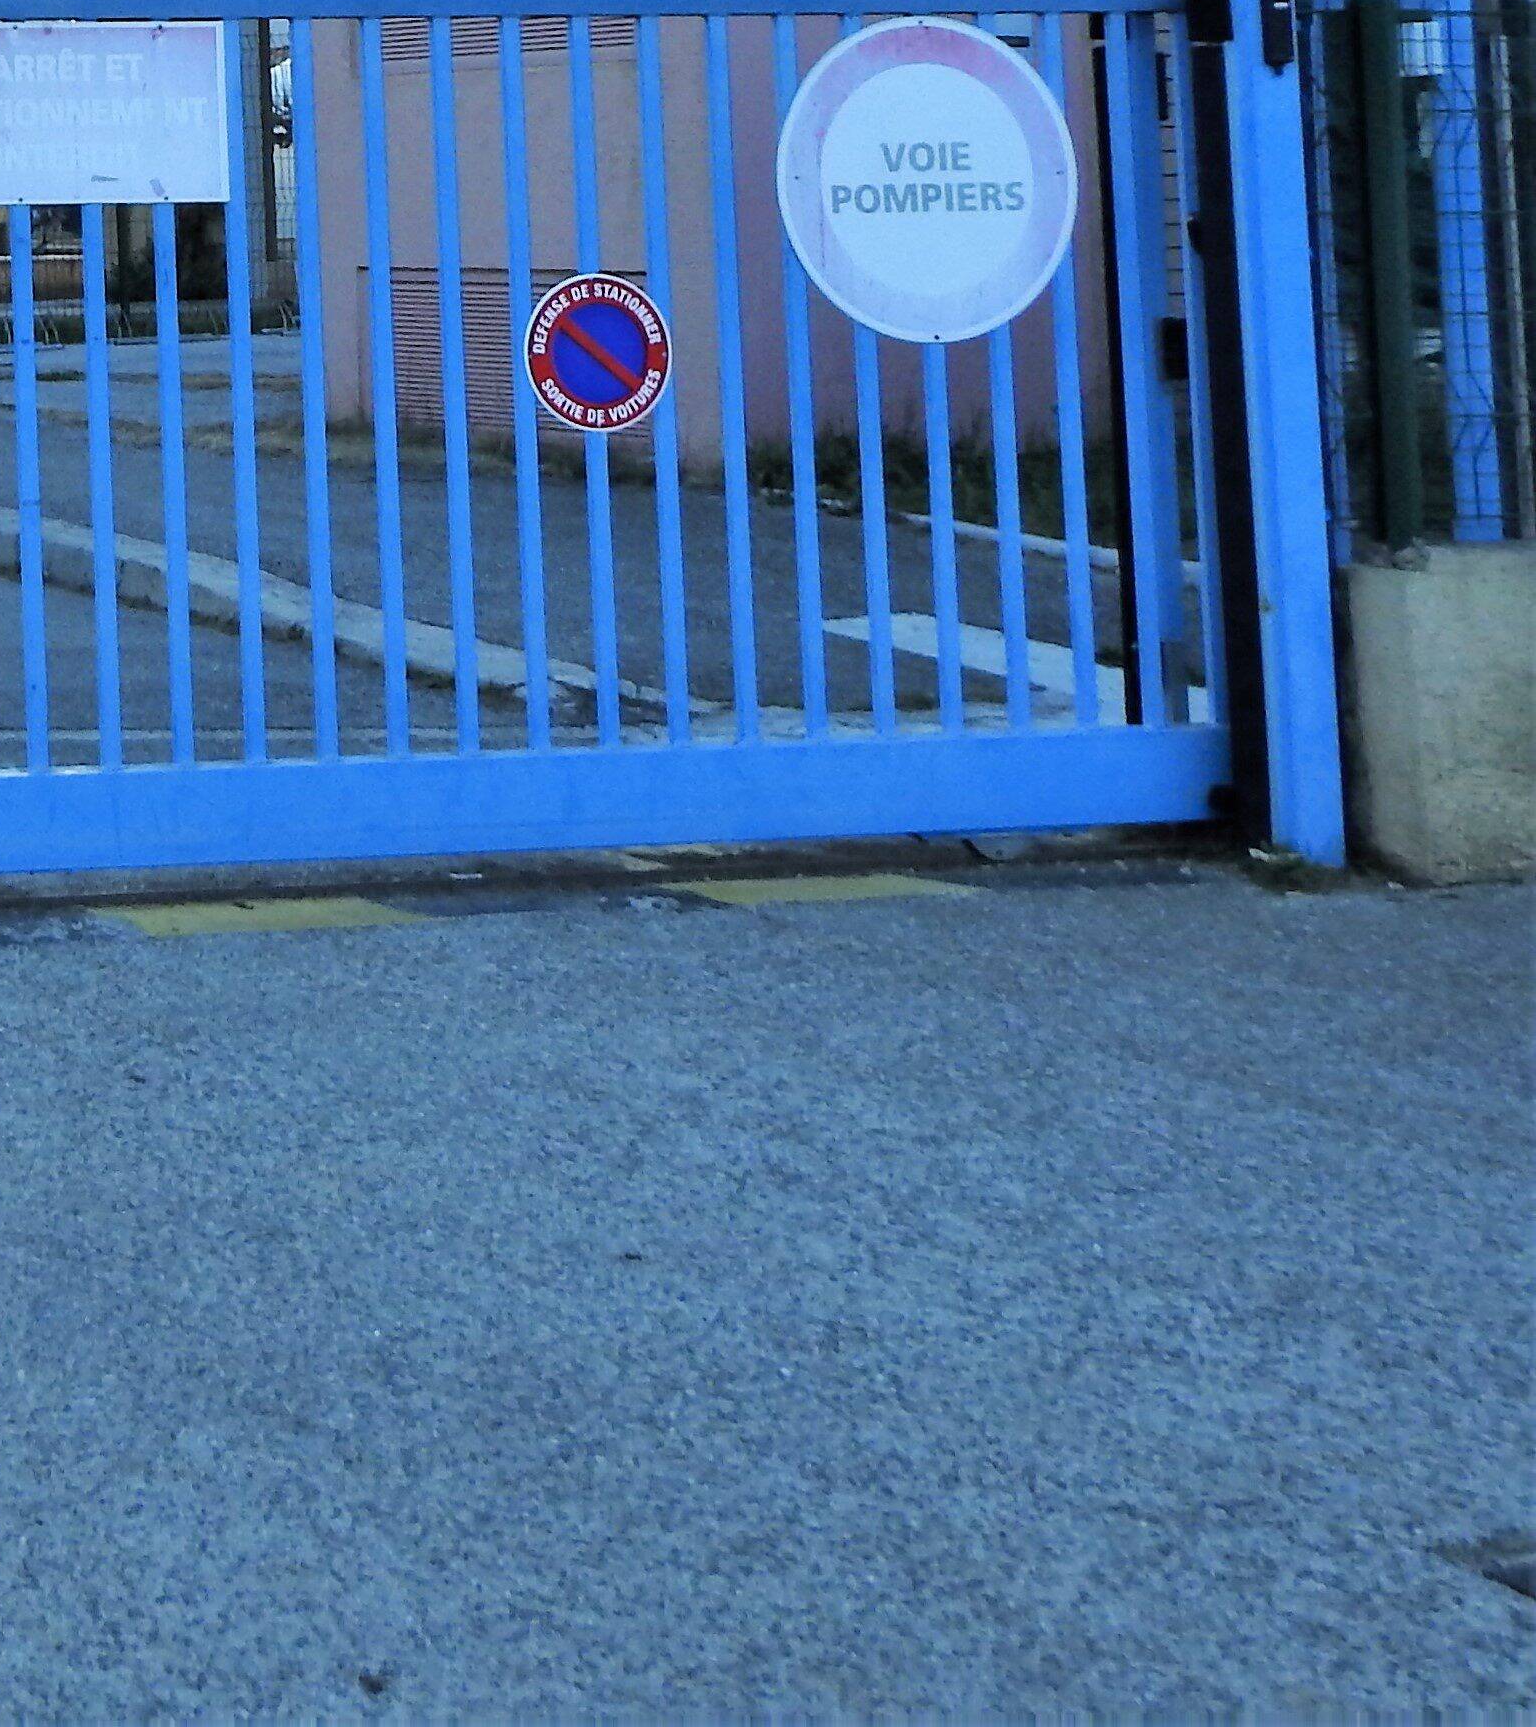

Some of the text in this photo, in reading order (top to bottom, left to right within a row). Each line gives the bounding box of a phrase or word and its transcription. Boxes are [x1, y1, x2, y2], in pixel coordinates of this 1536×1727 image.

[105, 54, 144, 83] ET
[881, 141, 971, 172] VOIE
[831, 182, 1025, 214] POMPIERS
[532, 283, 662, 355] DEFENSE DE STATIONNER
[541, 368, 661, 425] SORTIE DE VOITURES
